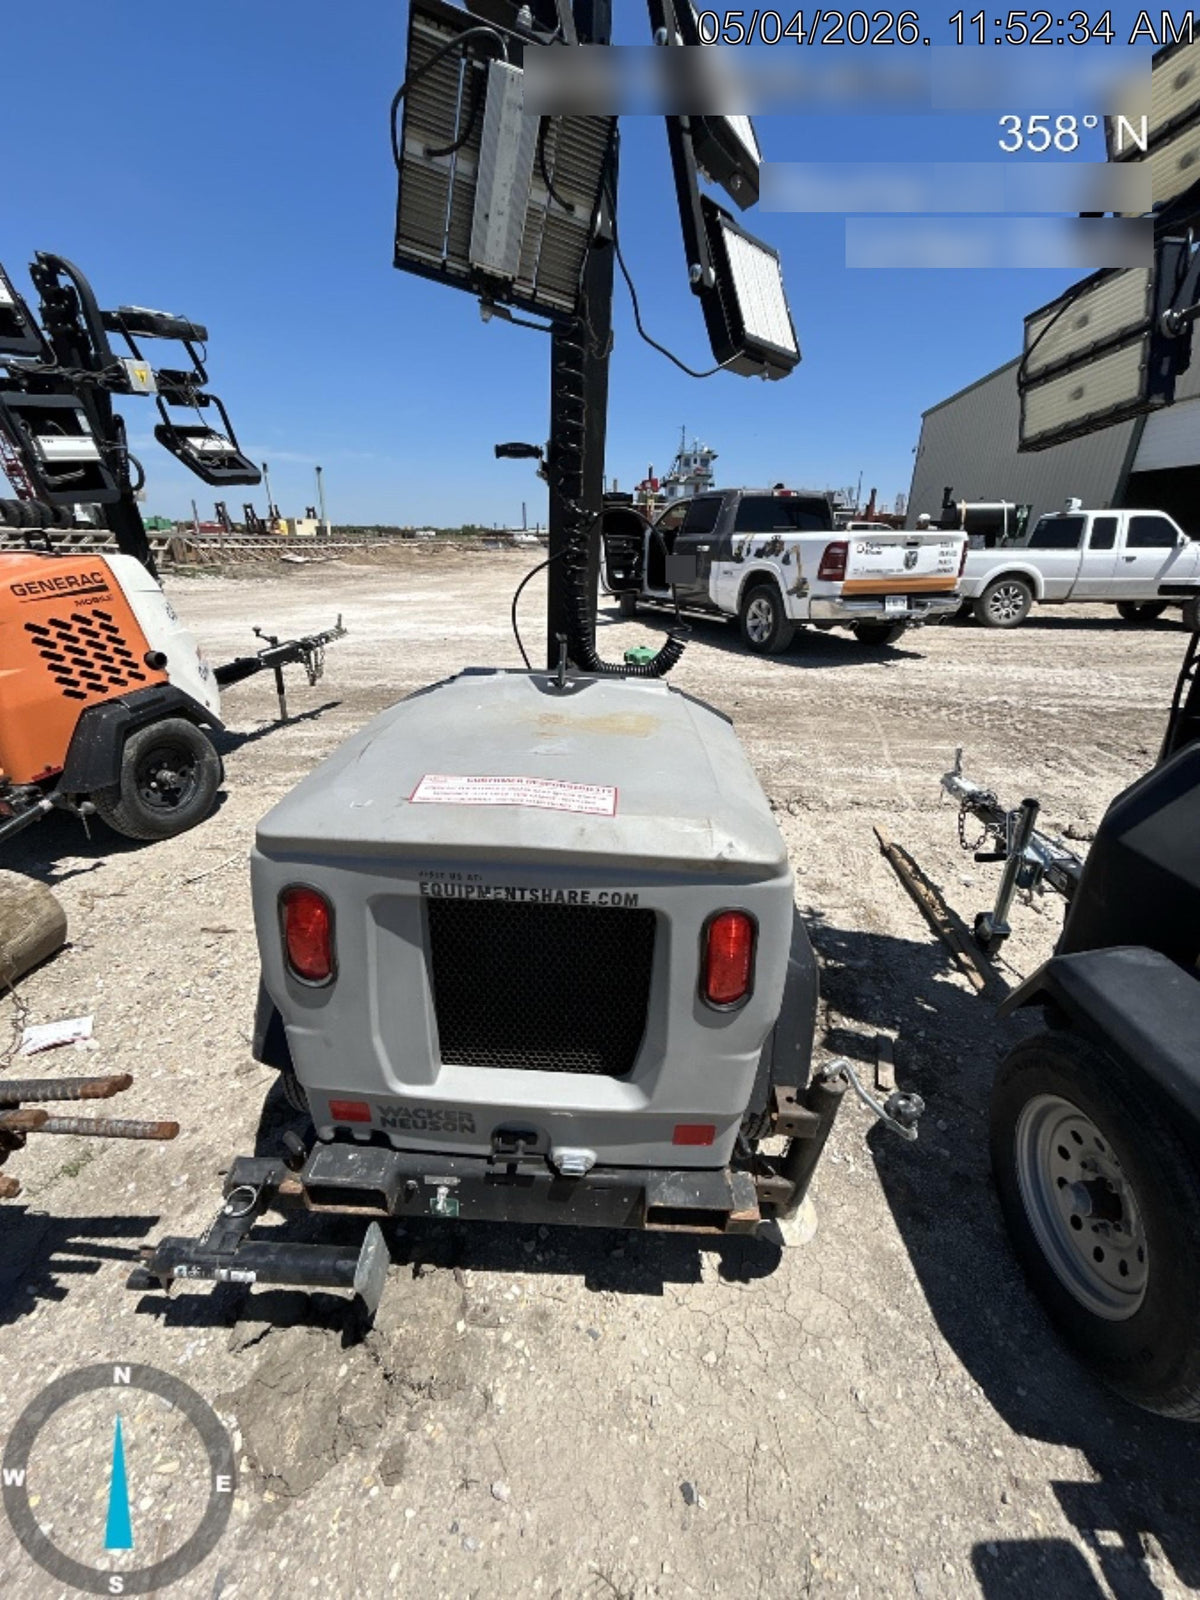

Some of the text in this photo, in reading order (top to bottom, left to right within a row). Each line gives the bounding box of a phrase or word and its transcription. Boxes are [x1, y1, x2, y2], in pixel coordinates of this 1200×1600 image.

[10, 571, 105, 596] GENERAC
[419, 881, 639, 907] EQUIPMENTSHARE.COM
[377, 1104, 473, 1122] WACKER
[380, 1116, 476, 1134] NEUSON
